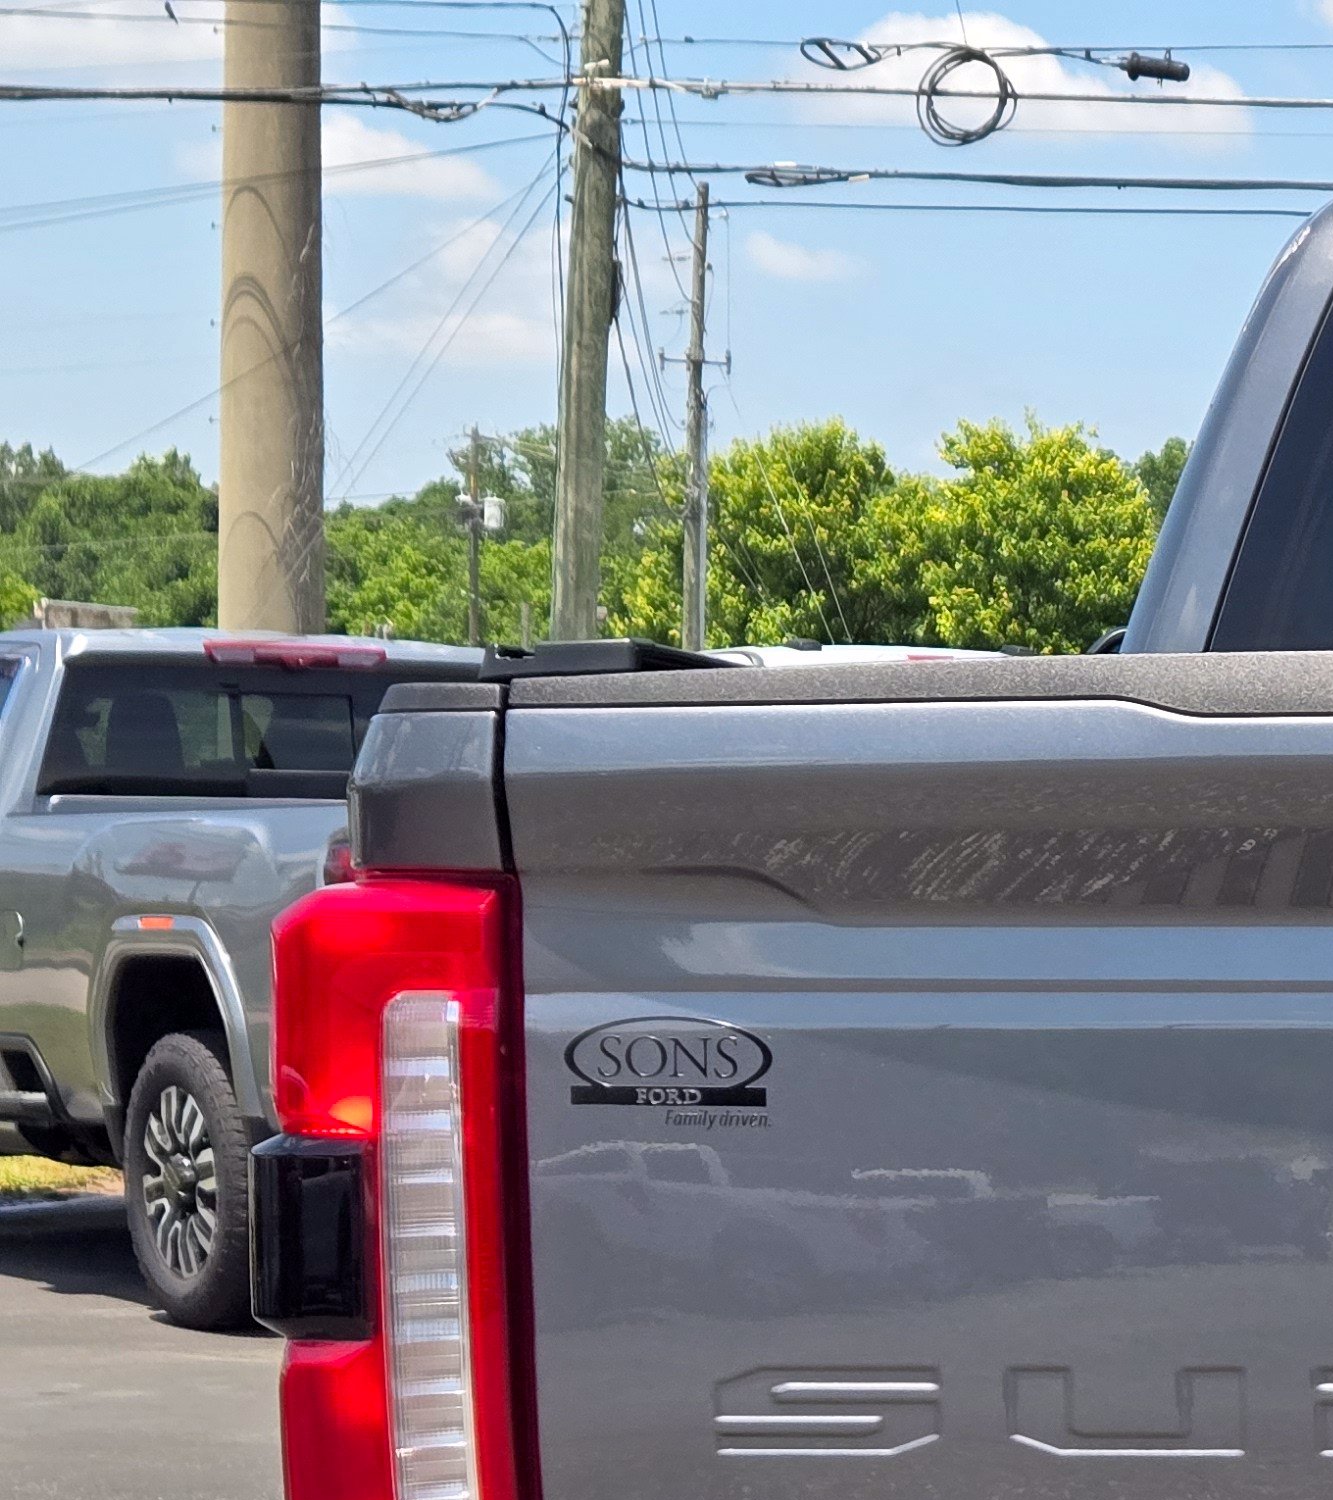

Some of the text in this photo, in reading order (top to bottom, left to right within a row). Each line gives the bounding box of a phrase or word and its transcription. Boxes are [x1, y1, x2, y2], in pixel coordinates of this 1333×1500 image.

[597, 1035, 738, 1079] SONS
[635, 1088, 702, 1105] FORD
[664, 1109, 772, 1130] Family driven.
